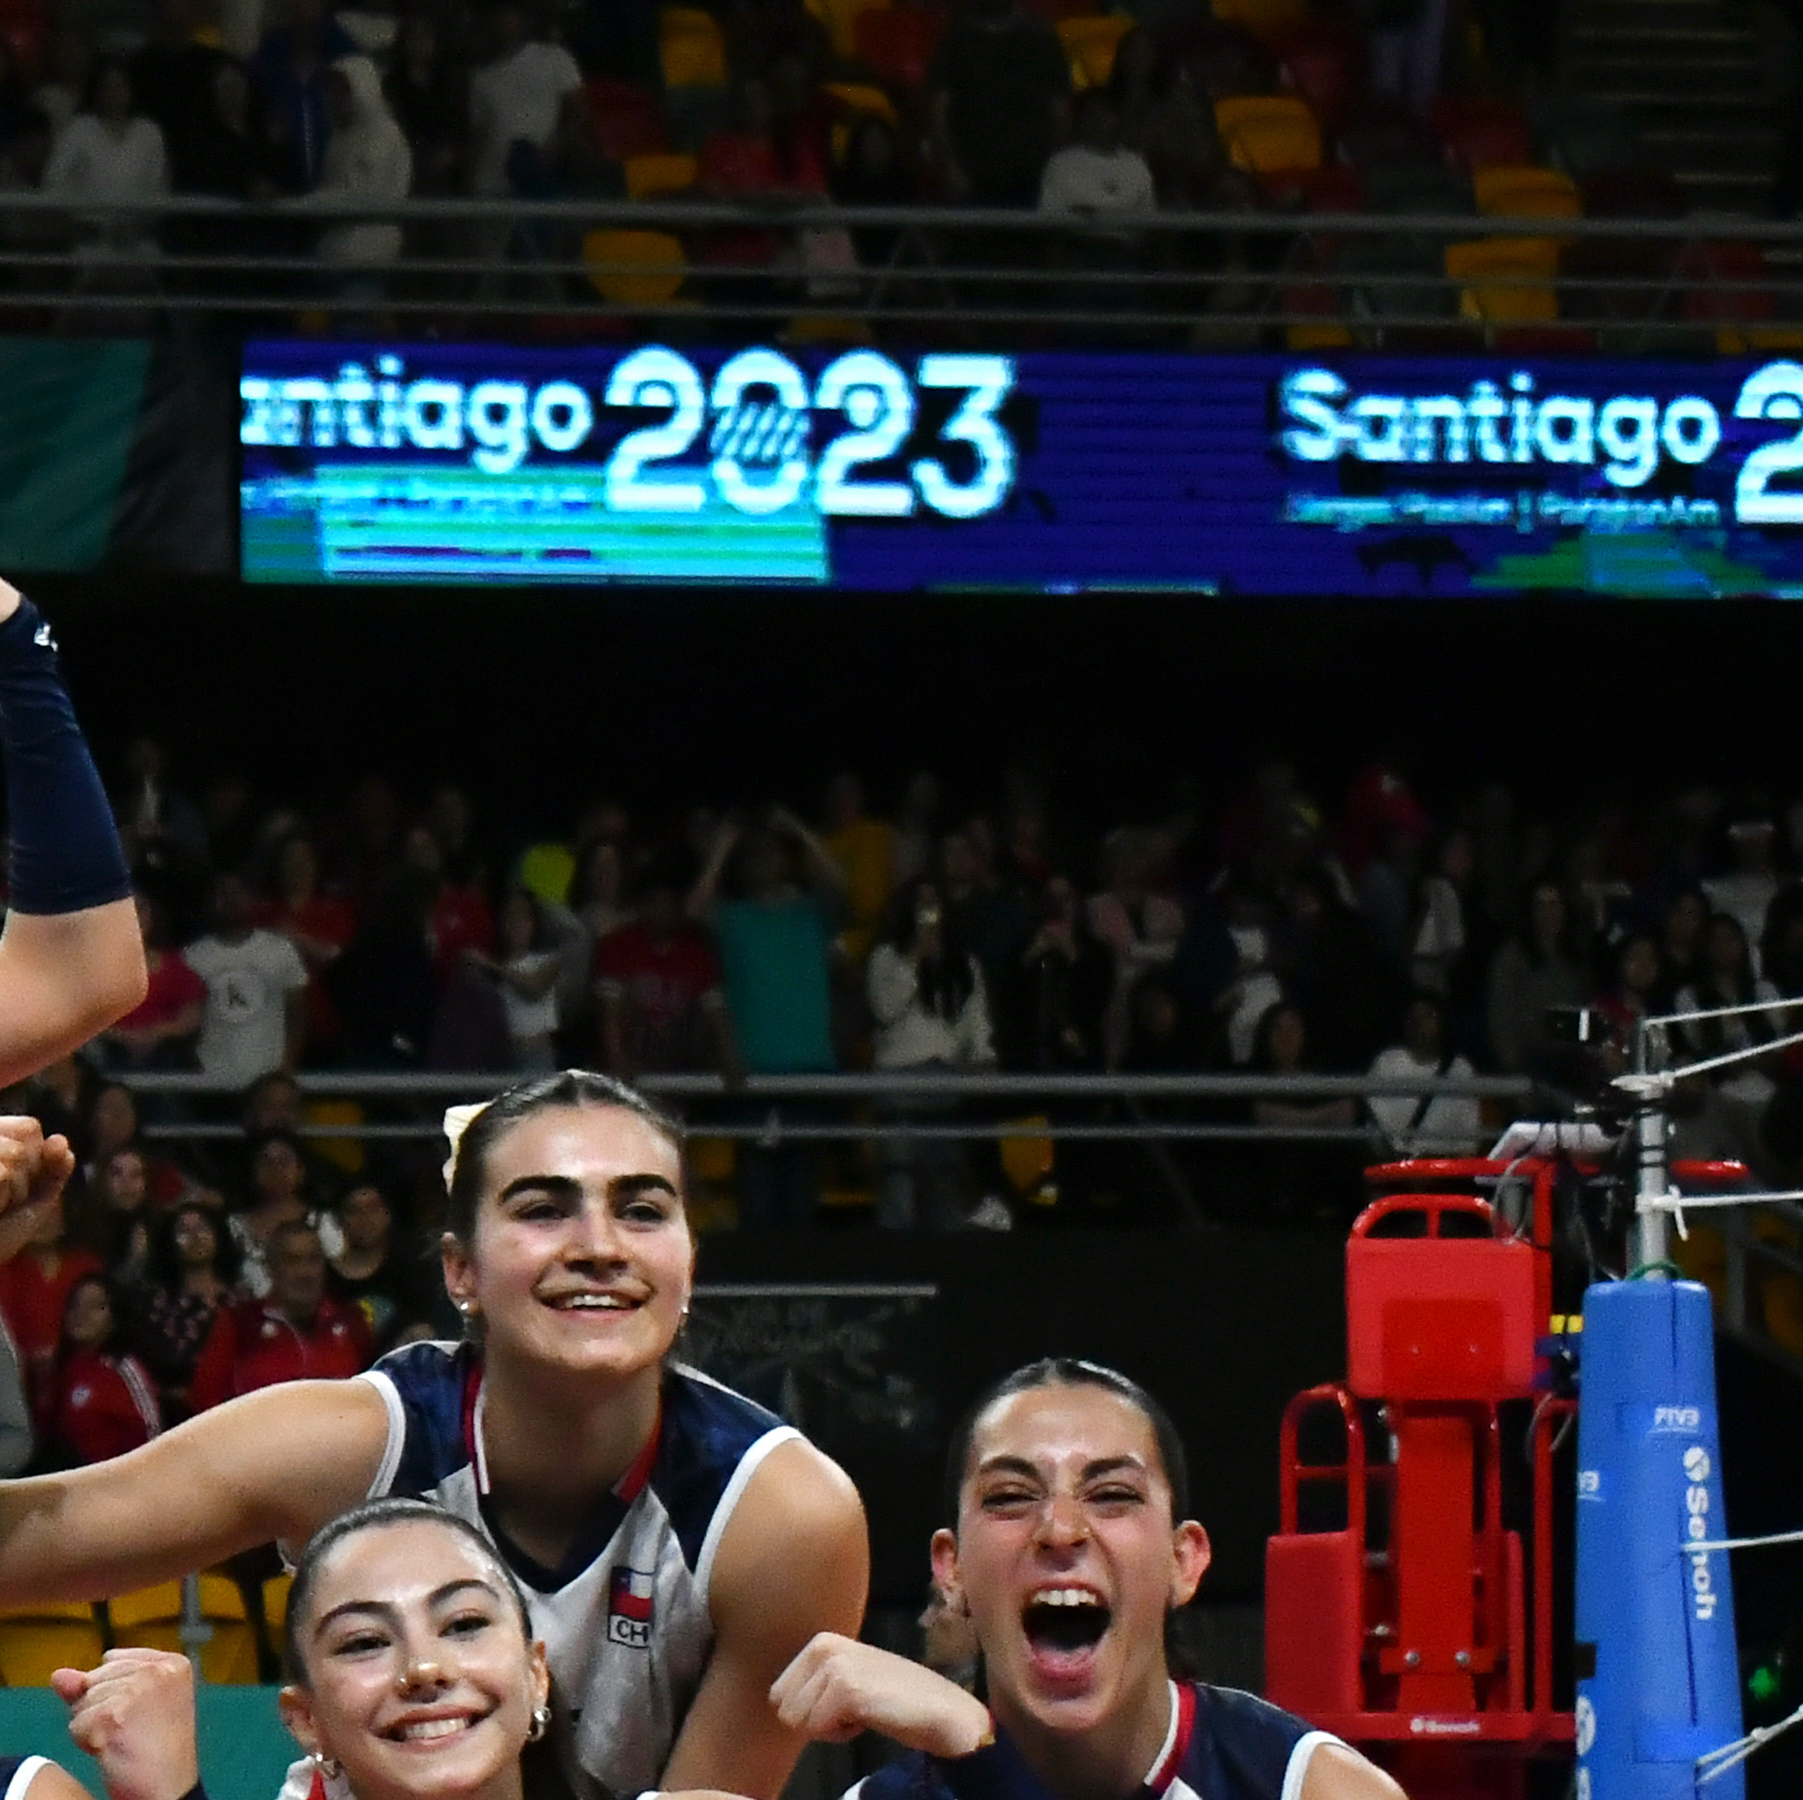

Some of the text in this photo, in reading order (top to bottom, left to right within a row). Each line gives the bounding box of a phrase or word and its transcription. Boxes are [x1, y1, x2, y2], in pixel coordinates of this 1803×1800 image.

[606, 345, 1016, 518] 2023
[1280, 367, 1720, 487] Santiago
[616, 1619, 648, 1642] CH
